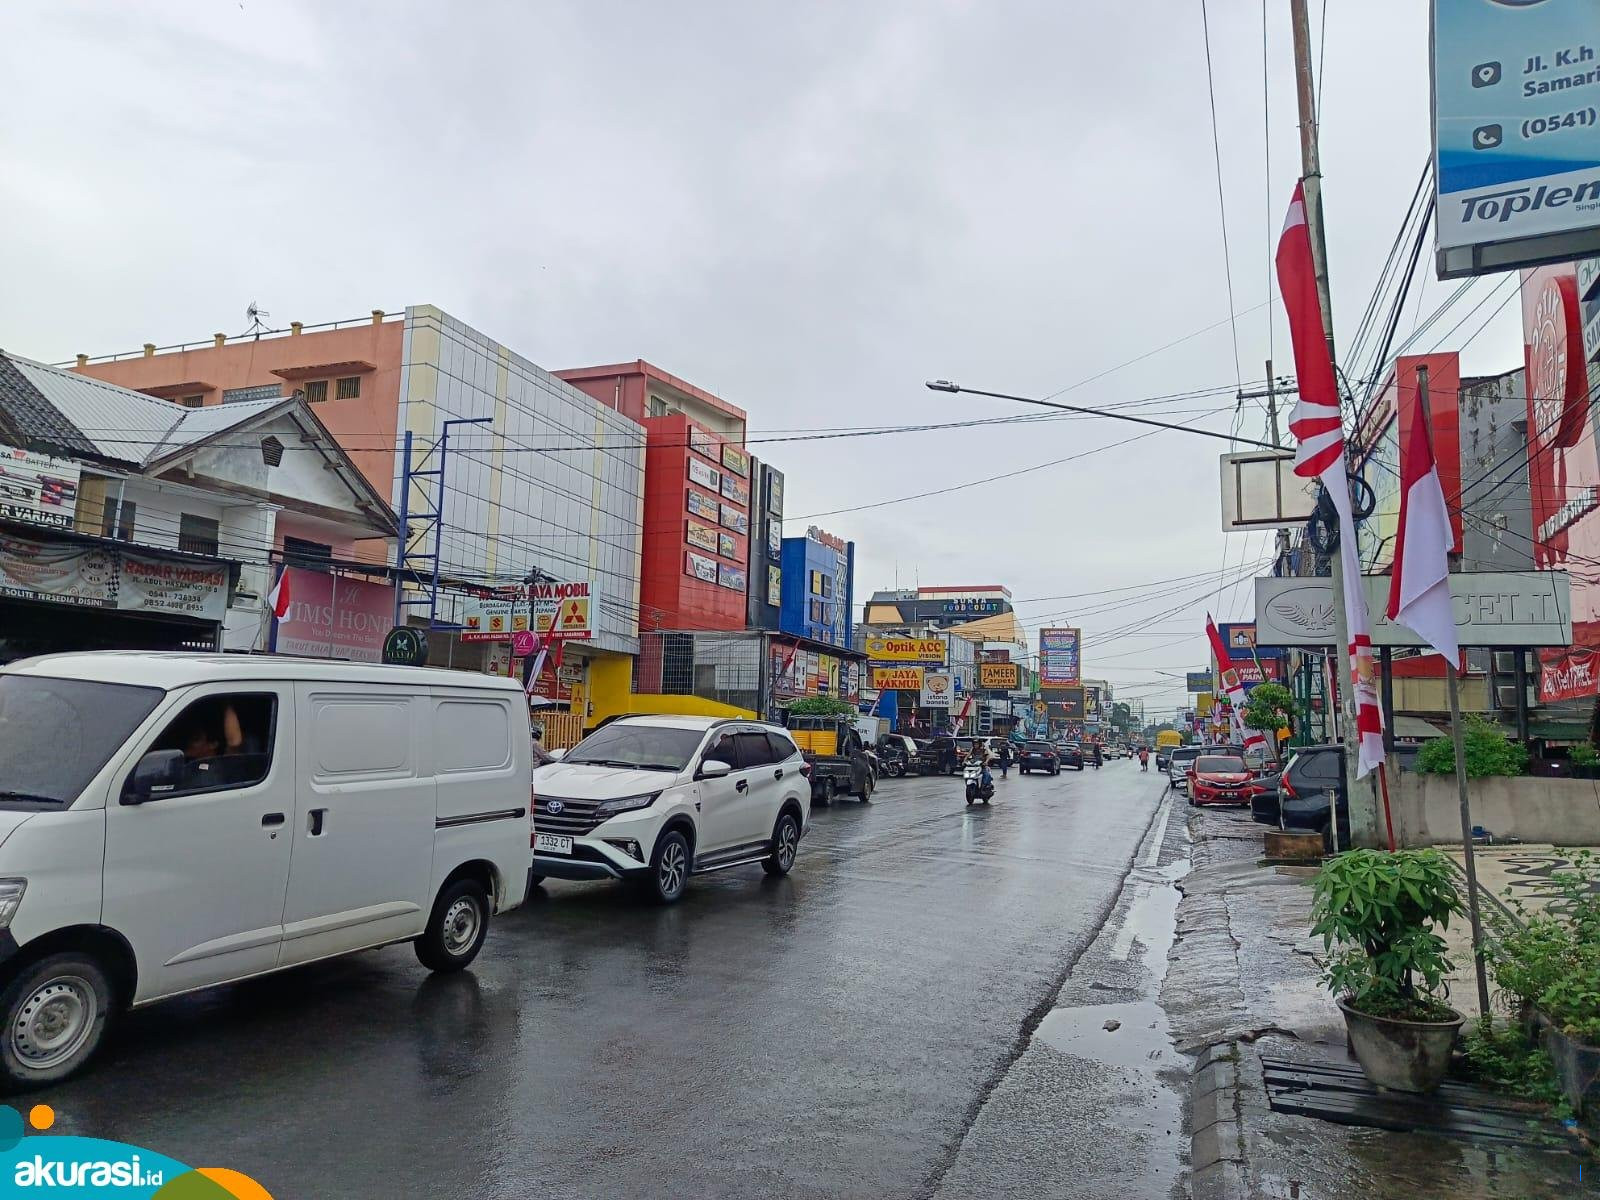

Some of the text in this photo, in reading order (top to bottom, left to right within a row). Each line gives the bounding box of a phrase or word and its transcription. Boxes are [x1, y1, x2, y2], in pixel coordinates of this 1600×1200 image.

[1523, 56, 1548, 74] Jl.
[1521, 107, 1597, 138] (0541)
[15, 506, 68, 526] VARIASI
[554, 583, 590, 598] MOBIL
[6, 589, 104, 607] SOLITE TERSEDIA DISINI
[943, 603, 998, 611] FOOD COURT
[886, 641, 941, 654] Optik ACC
[892, 670, 918, 679] JAYA
[982, 668, 1016, 678] TAMEER
[876, 679, 921, 689] MAKMUR
[982, 677, 1016, 685] Carpets
[540, 835, 559, 848] 1332
[560, 838, 570, 849] CT
